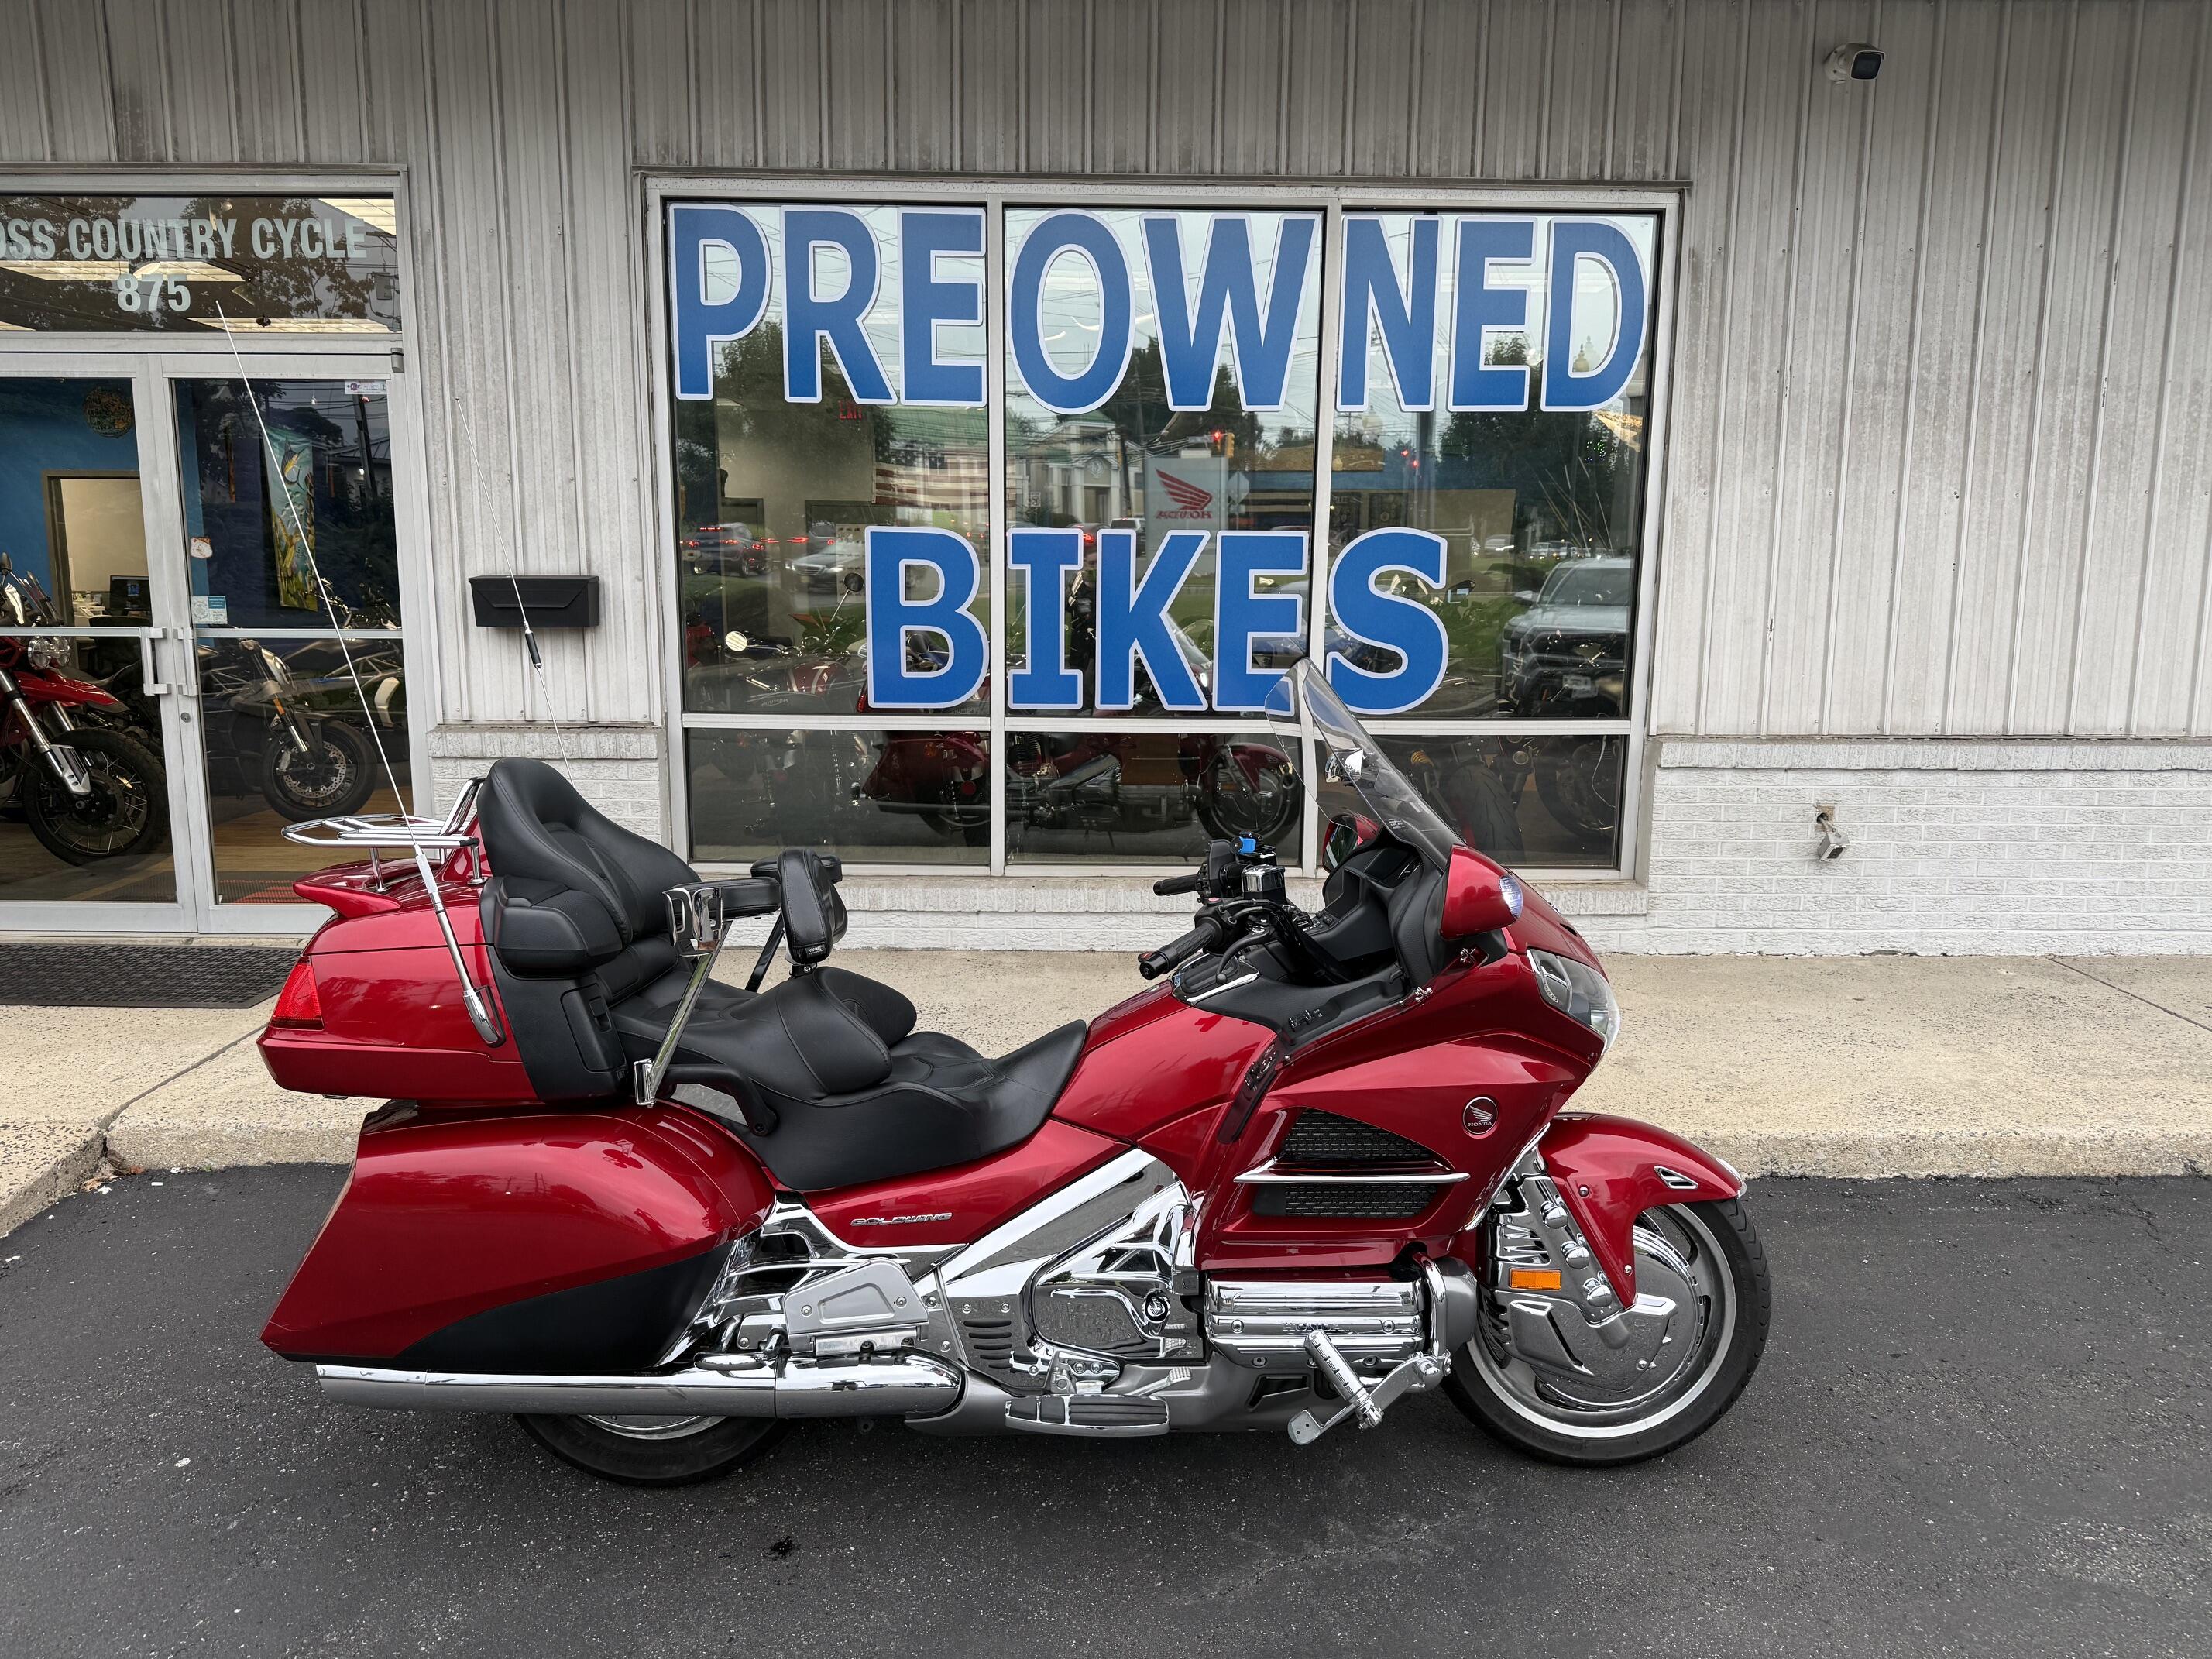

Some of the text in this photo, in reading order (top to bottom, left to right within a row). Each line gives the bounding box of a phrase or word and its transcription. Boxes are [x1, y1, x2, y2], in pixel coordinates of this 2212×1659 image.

[0, 218, 367, 259] SS COUNTRY CYCLE
[117, 273, 191, 312] 875
[669, 202, 1648, 414] PREOWNED
[864, 525, 1448, 715] BIKES
[850, 1212, 953, 1226] GOLDWING
